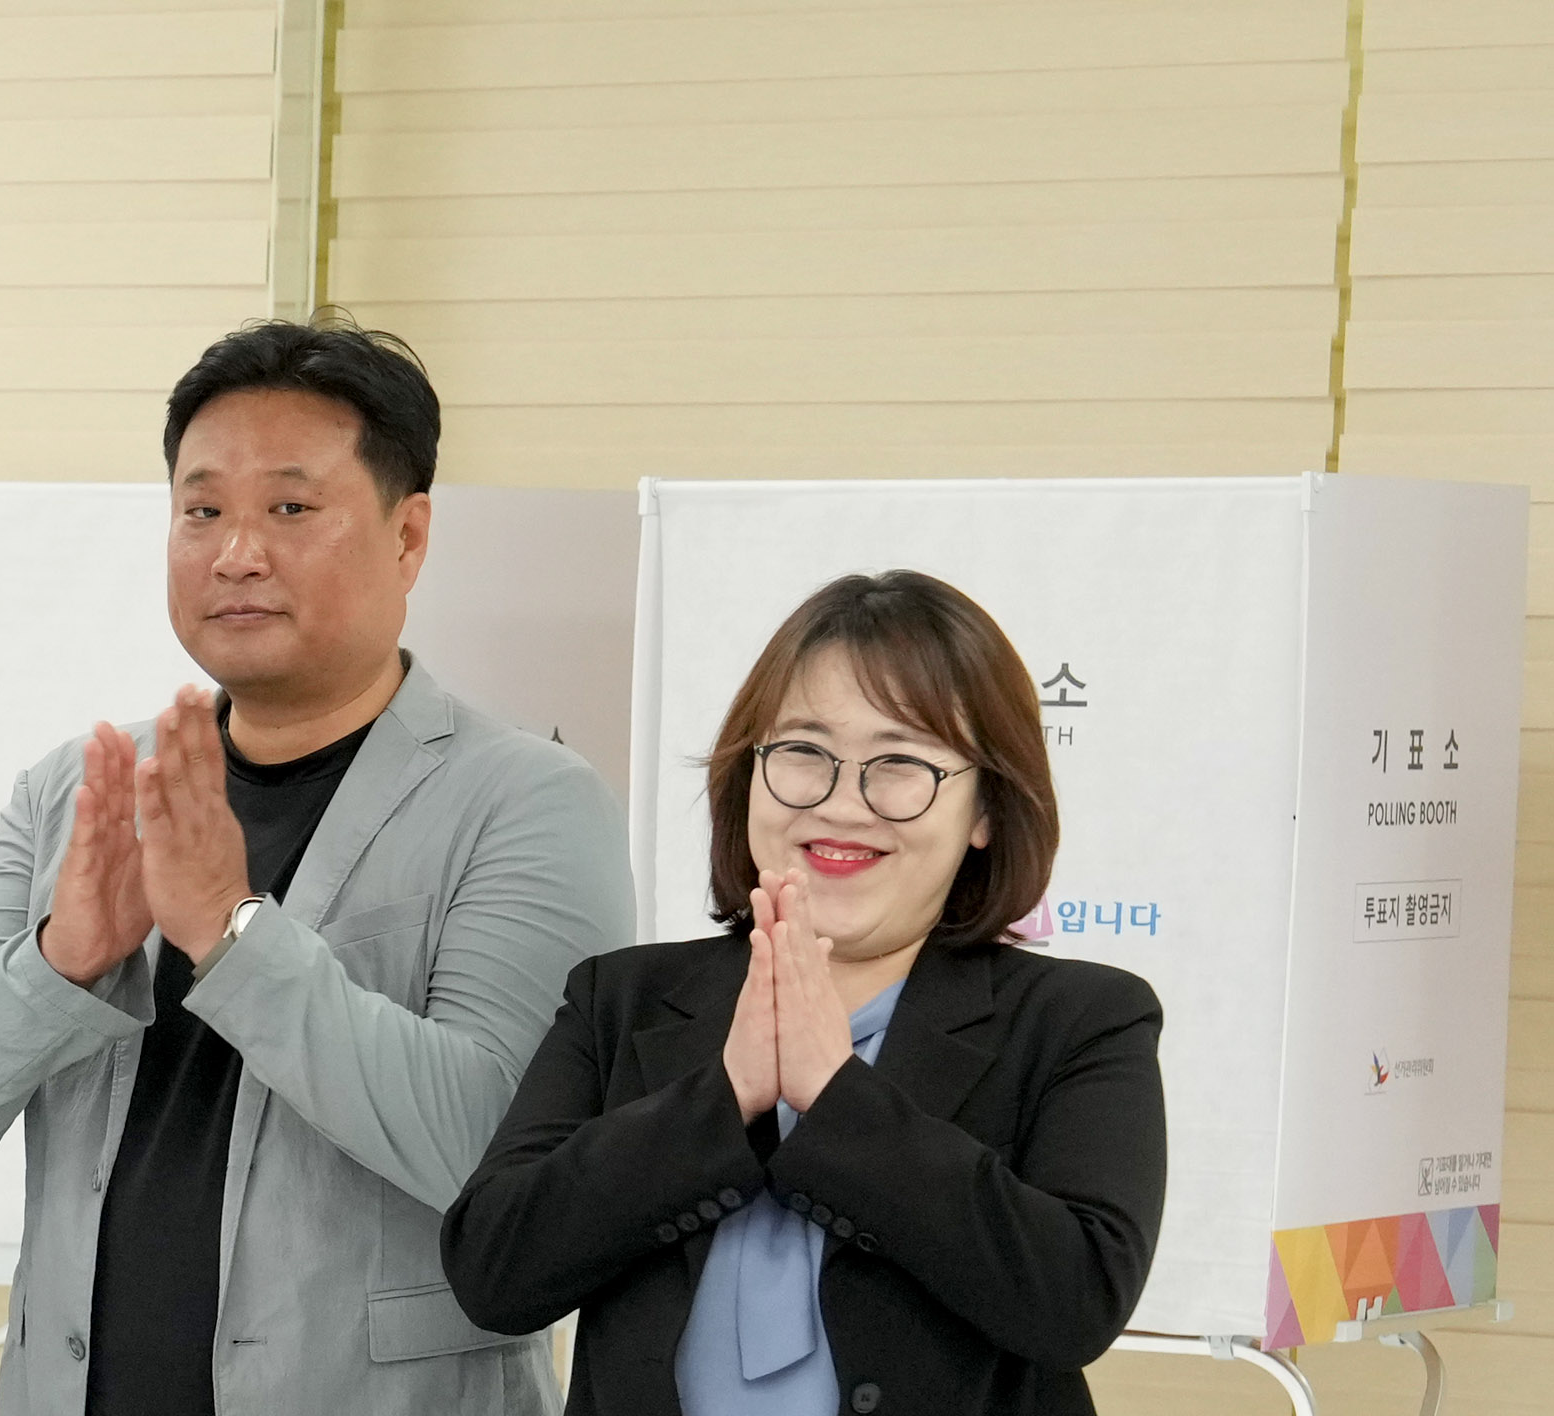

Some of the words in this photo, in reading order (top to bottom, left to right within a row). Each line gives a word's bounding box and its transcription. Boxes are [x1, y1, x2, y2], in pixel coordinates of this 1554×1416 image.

[1368, 802, 1417, 826] POLLING
[1420, 800, 1458, 825] BOOTH
[1364, 894, 1400, 929] 투표지
[1405, 892, 1452, 927] 촬영금지
